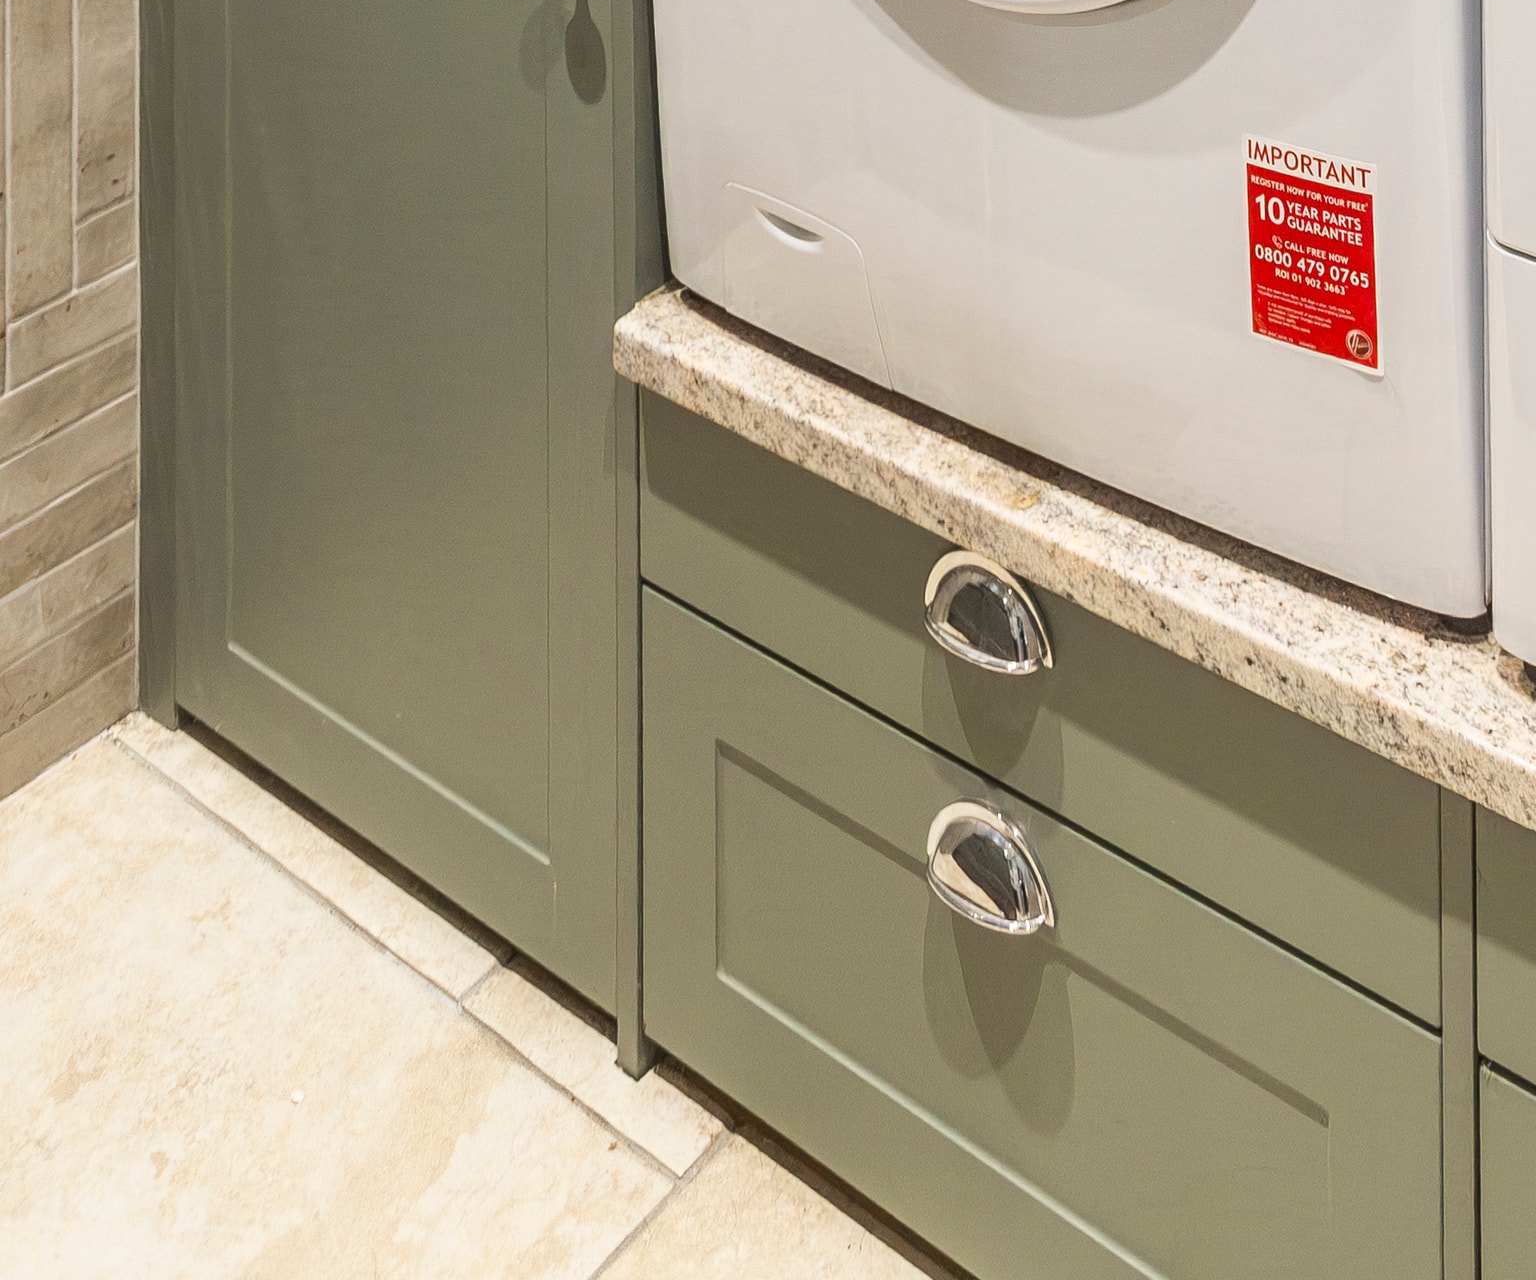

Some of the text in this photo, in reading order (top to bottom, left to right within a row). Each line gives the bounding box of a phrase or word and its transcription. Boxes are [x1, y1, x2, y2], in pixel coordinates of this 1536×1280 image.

[1248, 138, 1372, 188] IMPORTANT
[1250, 174, 1286, 192] REGISTER
[1286, 185, 1305, 197] NOW
[1306, 190, 1322, 202] FOR
[1323, 195, 1345, 208] YOUR
[1255, 193, 1286, 225] 10
[1286, 200, 1362, 232] YEAR PARTS
[1286, 216, 1363, 247] GUARANTEE
[1254, 244, 1370, 288] 0800 479 0765
[1284, 240, 1348, 265] CALL FREE NOW
[1275, 268, 1290, 280] ROI
[1292, 273, 1302, 284] 01
[1304, 276, 1322, 290] 902
